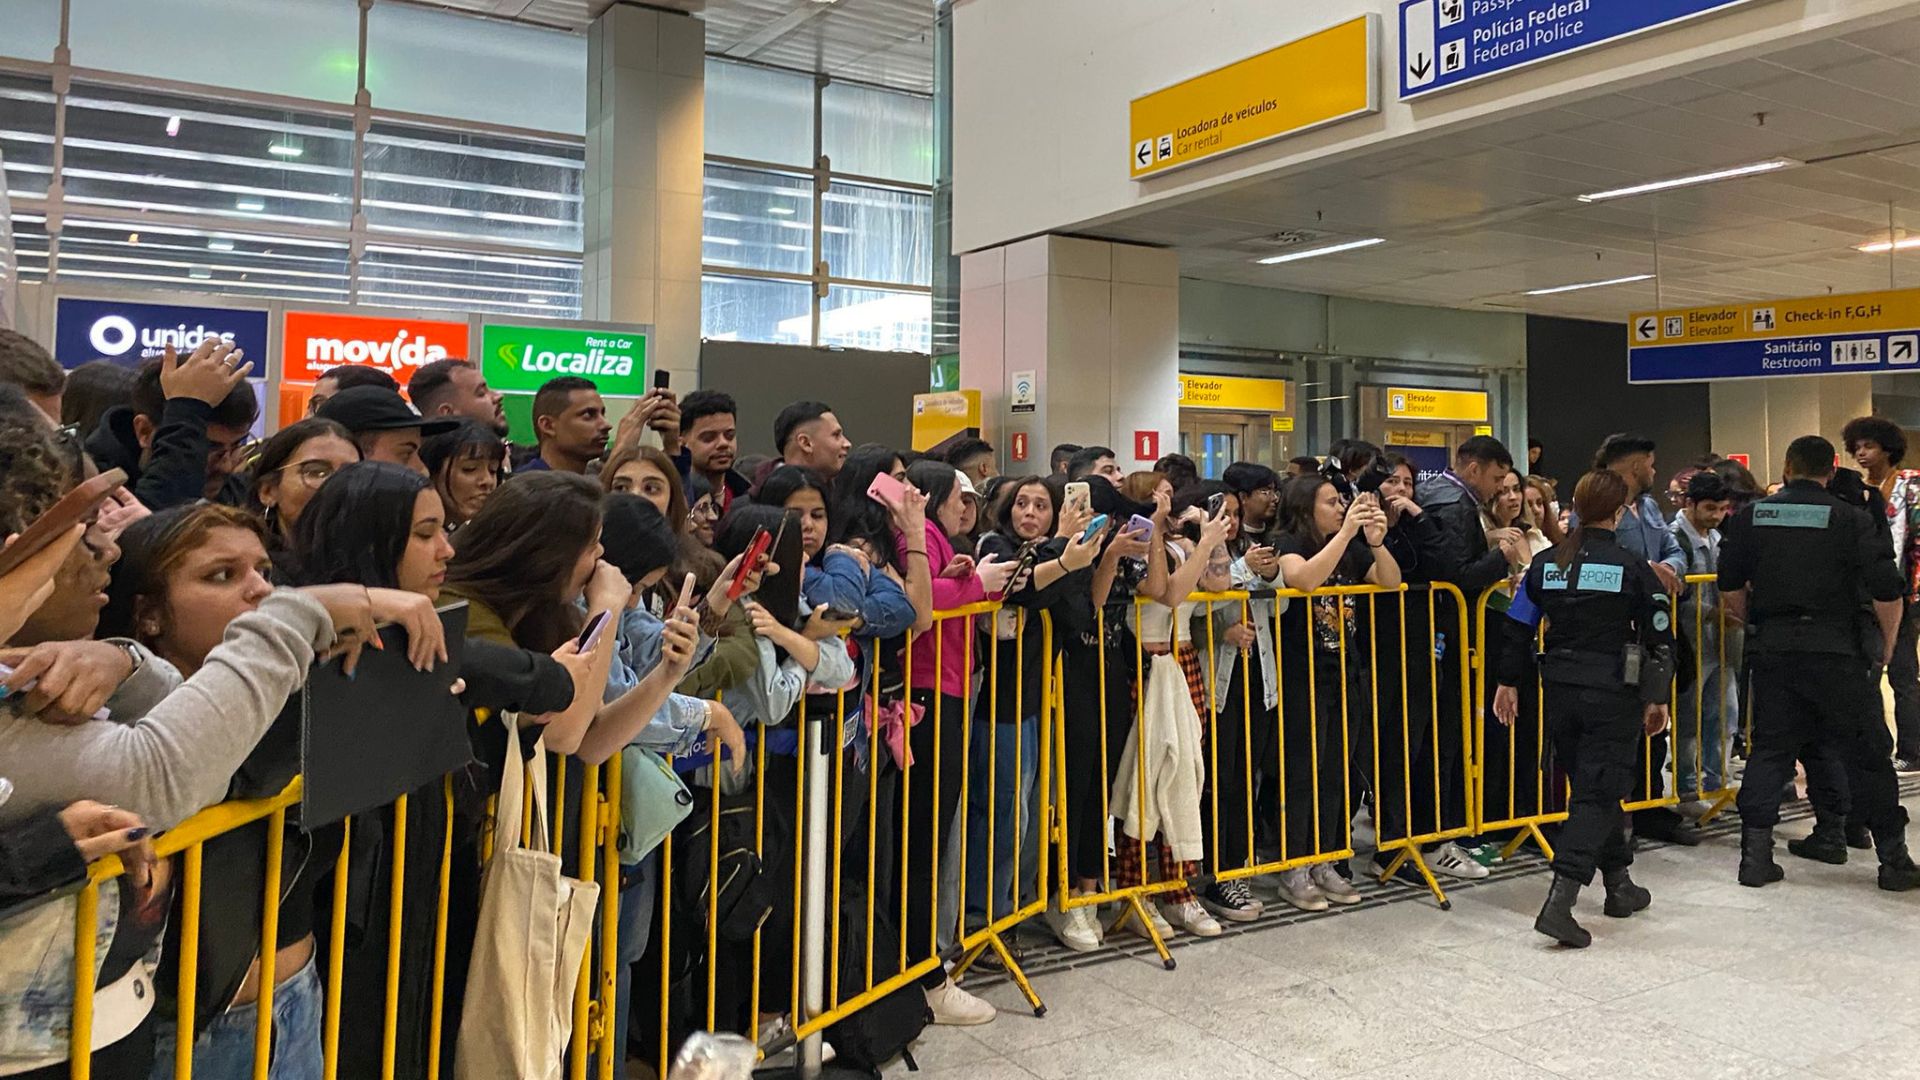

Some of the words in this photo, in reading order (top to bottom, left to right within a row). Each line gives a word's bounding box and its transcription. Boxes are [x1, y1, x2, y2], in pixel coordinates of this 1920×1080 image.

[1473, 17, 1524, 45] Polícia
[1473, 32, 1530, 65] Federal
[1535, 21, 1584, 46] Police
[1176, 118, 1219, 139] Locadora
[1221, 112, 1233, 126] de
[1235, 98, 1278, 121] veículos
[1176, 143, 1192, 156] Car
[1194, 130, 1223, 149] rental
[1689, 309, 1738, 323] Elevador
[1784, 307, 1841, 323] Check-in
[1845, 304, 1882, 320] F,G,H
[1689, 325, 1735, 337] Elevator
[306, 329, 448, 370] movida
[585, 336, 608, 348] Rent
[608, 339, 616, 348] a
[617, 338, 633, 349] Car
[1764, 339, 1822, 355] Sanitário
[521, 344, 634, 377] Localiza
[1762, 356, 1822, 370] Restroom
[1187, 379, 1223, 390] Elevador
[1187, 391, 1221, 402] Elevator
[1407, 393, 1437, 403] Elevador
[1407, 403, 1436, 413] Elevator
[1755, 509, 1780, 519] GRU
[1580, 570, 1621, 585] RPORT
